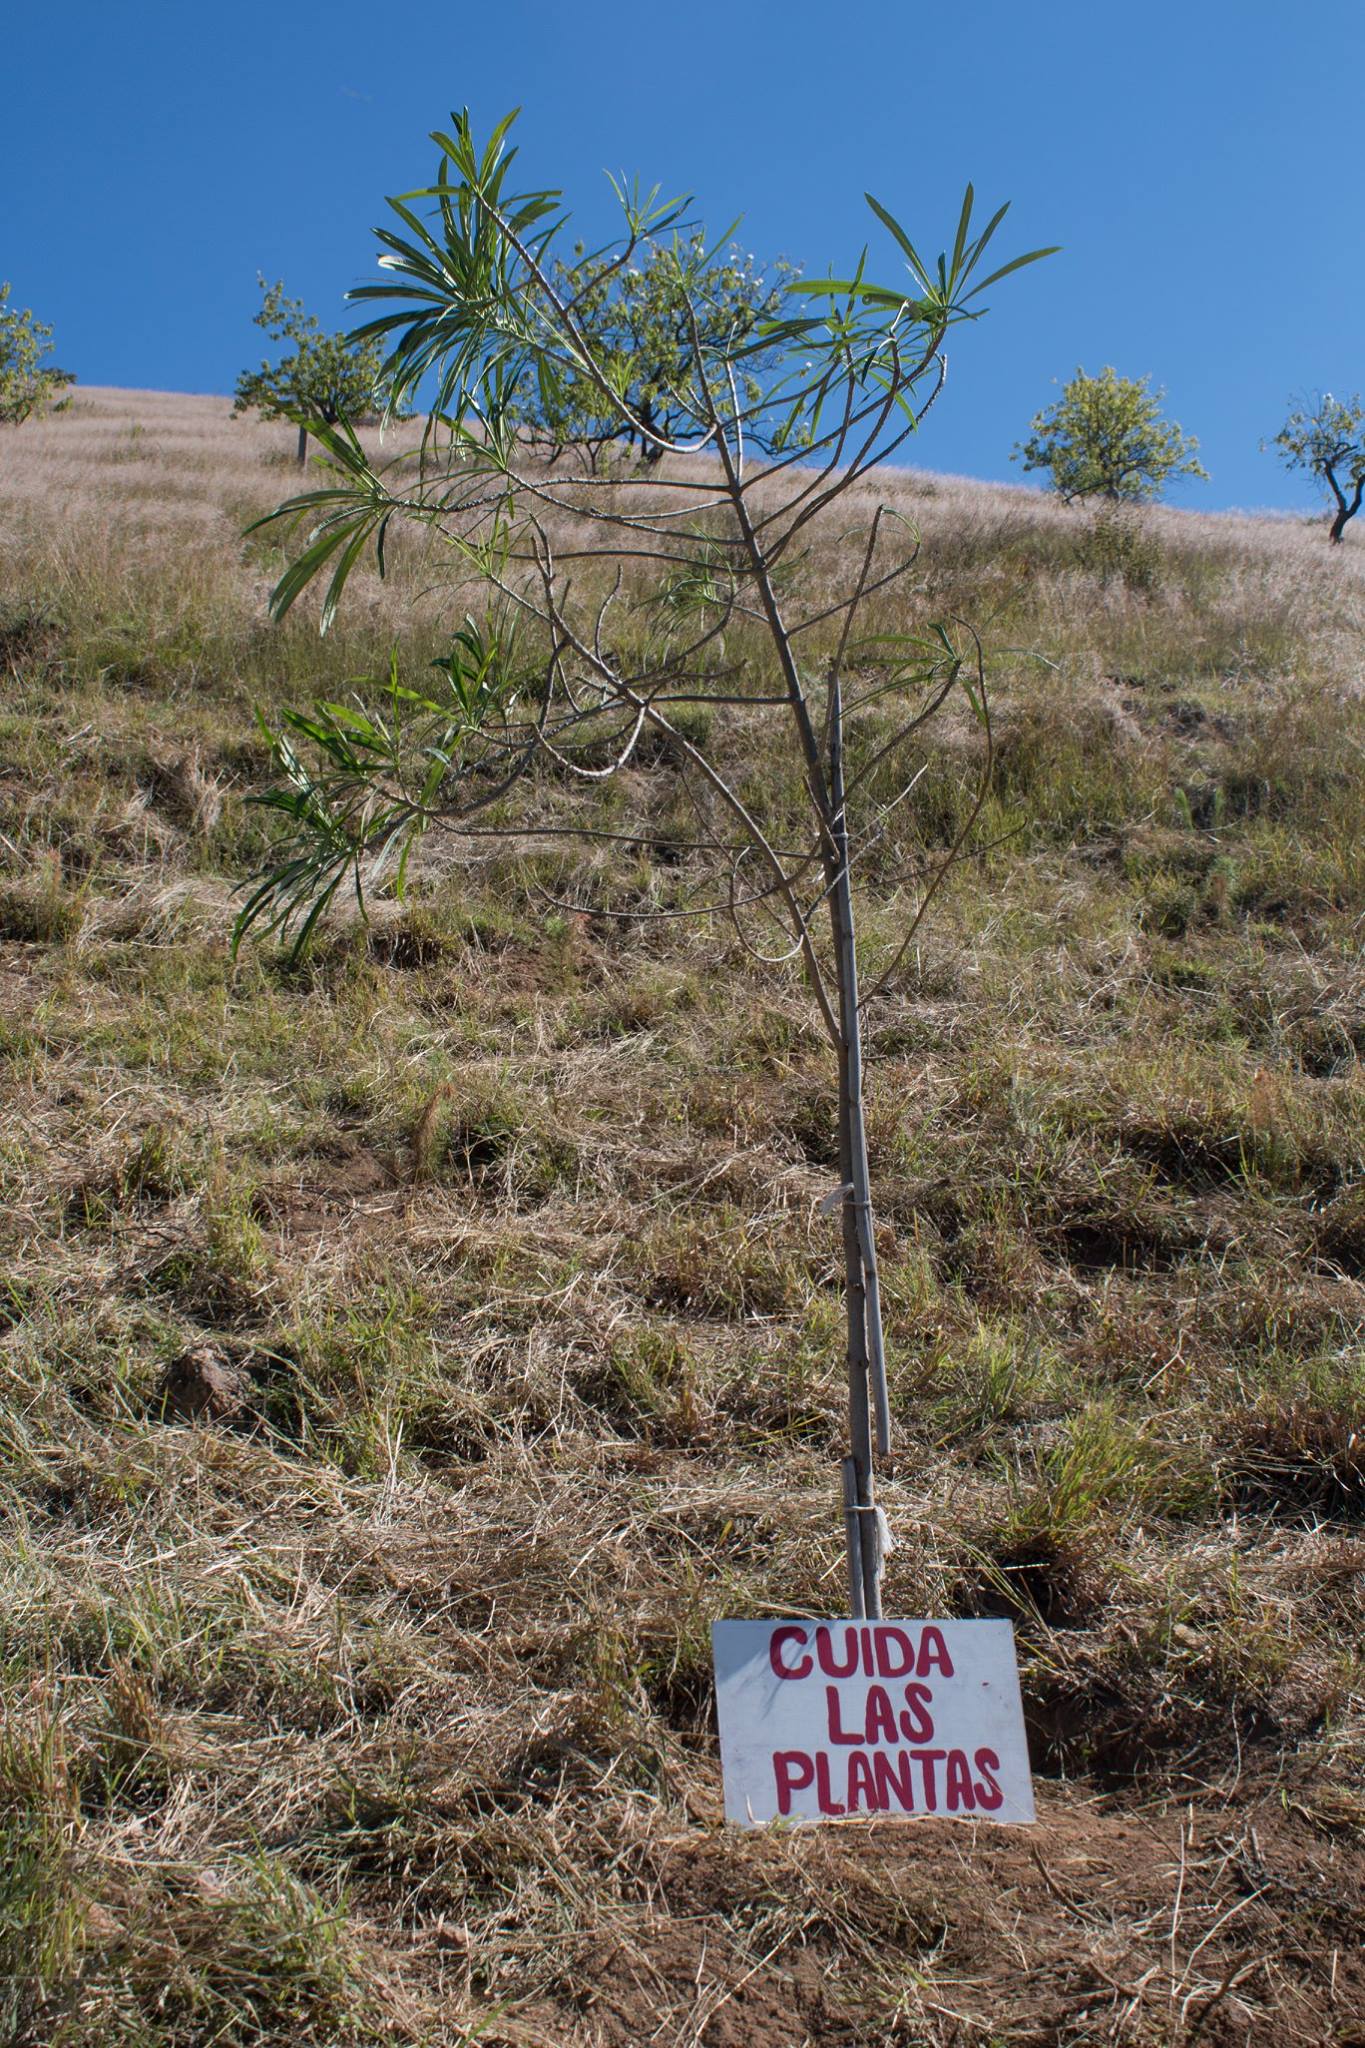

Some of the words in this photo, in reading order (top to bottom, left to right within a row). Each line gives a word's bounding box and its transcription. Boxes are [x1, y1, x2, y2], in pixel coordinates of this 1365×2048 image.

[769, 1625, 955, 1680] CUIDA
[826, 1682, 935, 1745] LAS
[772, 1747, 1004, 1816] PLANTAS
